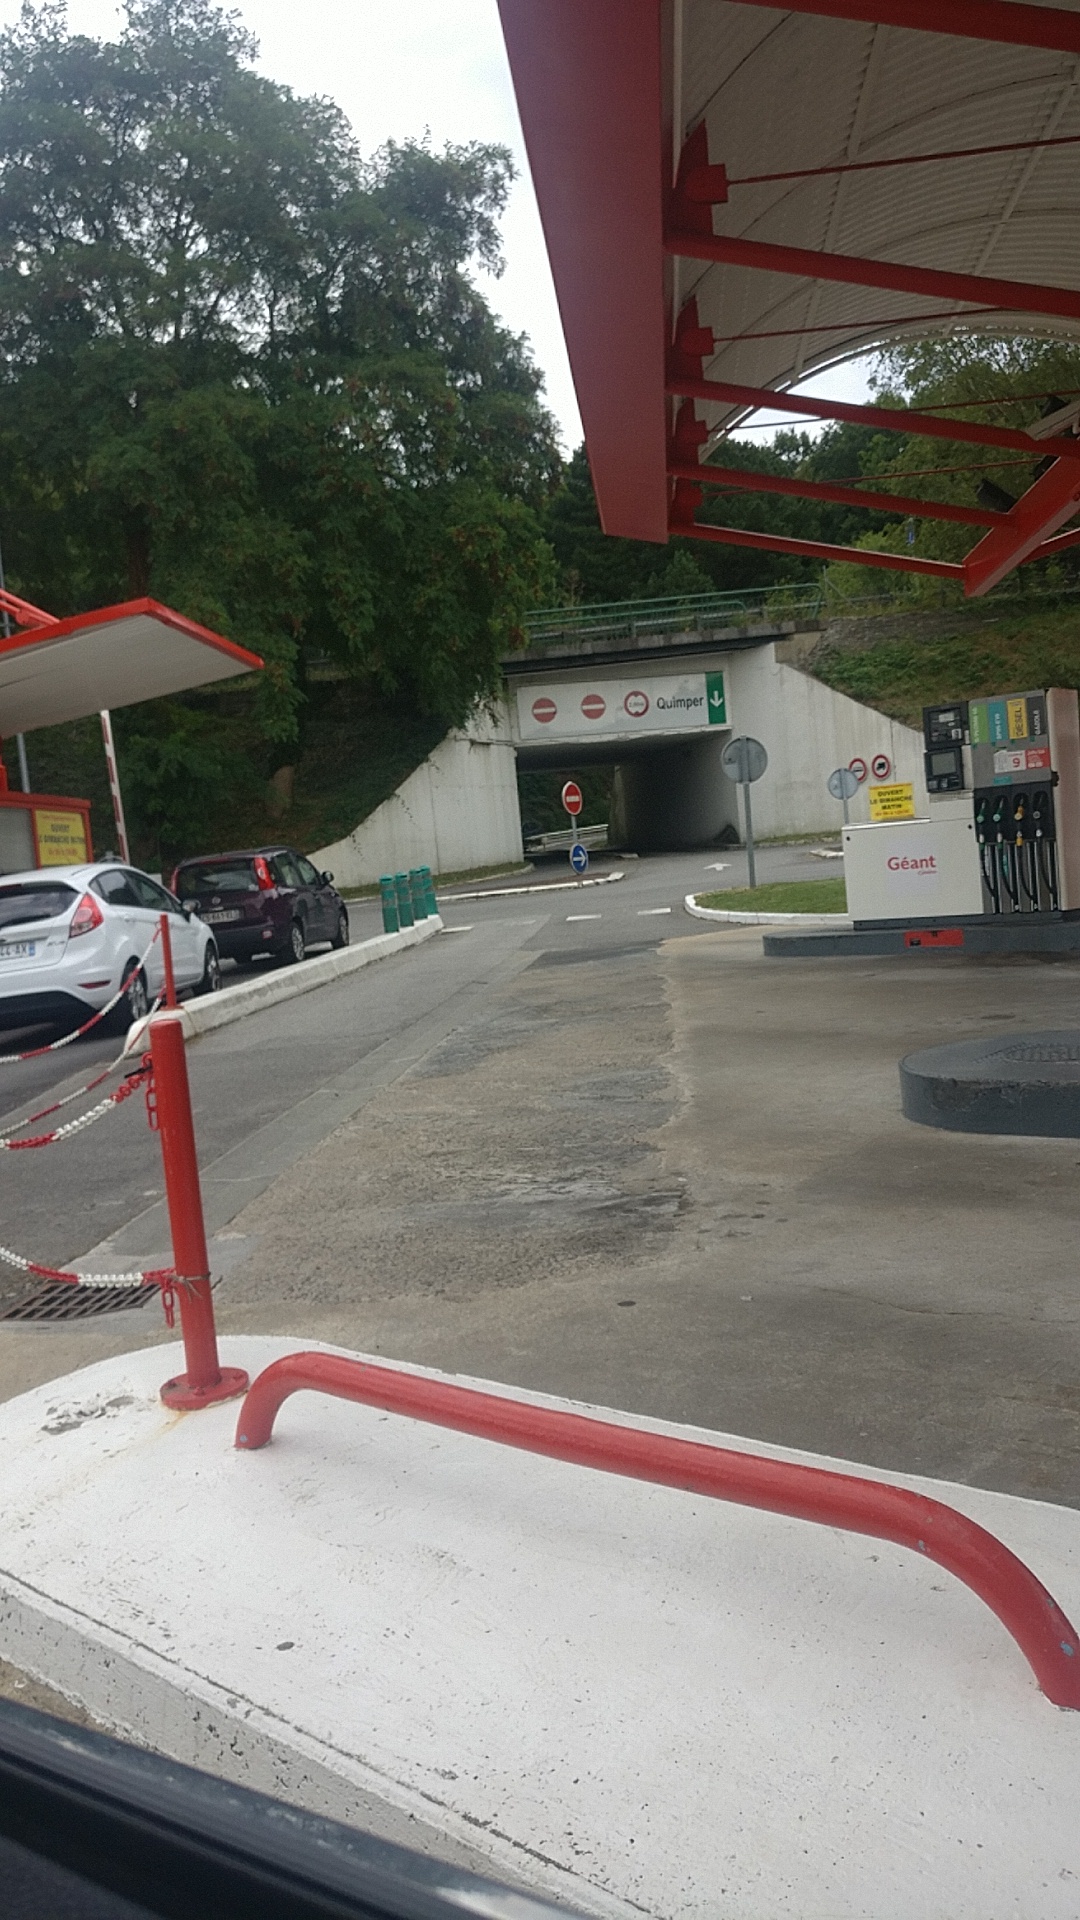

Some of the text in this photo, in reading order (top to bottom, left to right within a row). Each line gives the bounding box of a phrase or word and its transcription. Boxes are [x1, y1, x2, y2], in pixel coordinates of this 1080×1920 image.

[656, 696, 704, 710] Quimper
[1014, 707, 1024, 736] DIESEL
[877, 789, 903, 797] OUVERT
[879, 795, 912, 803] DIMANCHE
[887, 855, 937, 871] Géant
